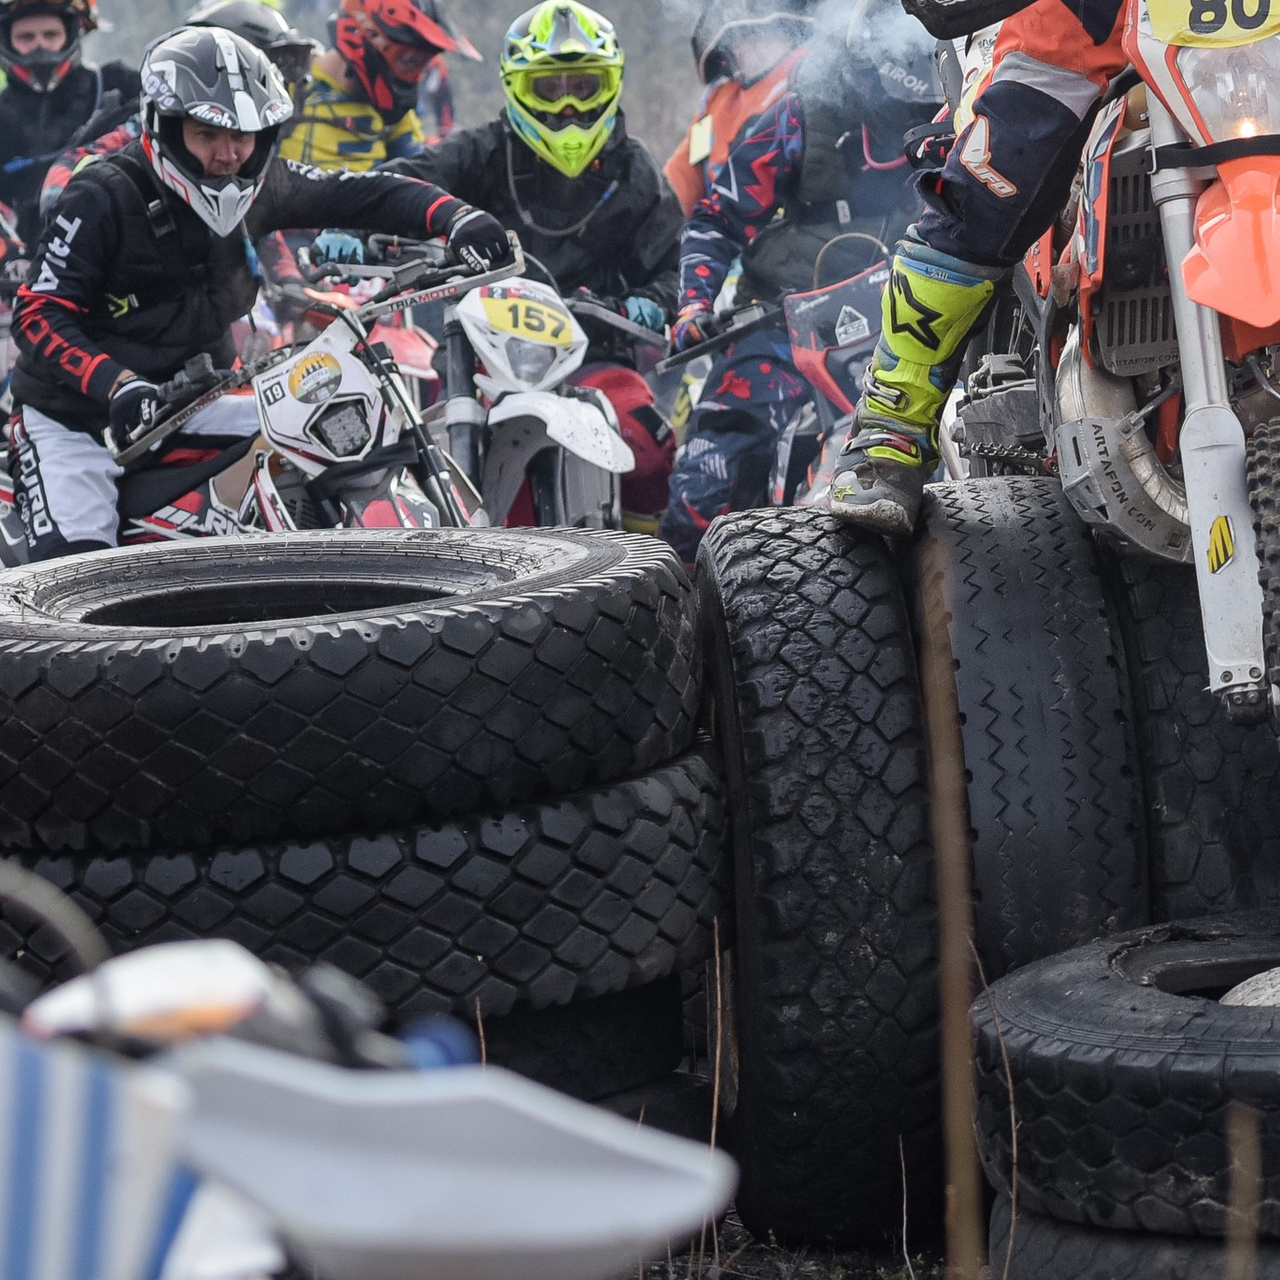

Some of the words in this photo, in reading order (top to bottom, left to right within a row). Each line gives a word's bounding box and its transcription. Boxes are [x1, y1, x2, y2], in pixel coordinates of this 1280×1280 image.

[188, 103, 233, 129] Airoh
[30, 214, 82, 292] TRIA
[388, 286, 458, 313] TRIAMOTO
[508, 304, 566, 339] 157
[264, 384, 284, 406] 19
[1092, 423, 1157, 531] ARTAFON.COM
